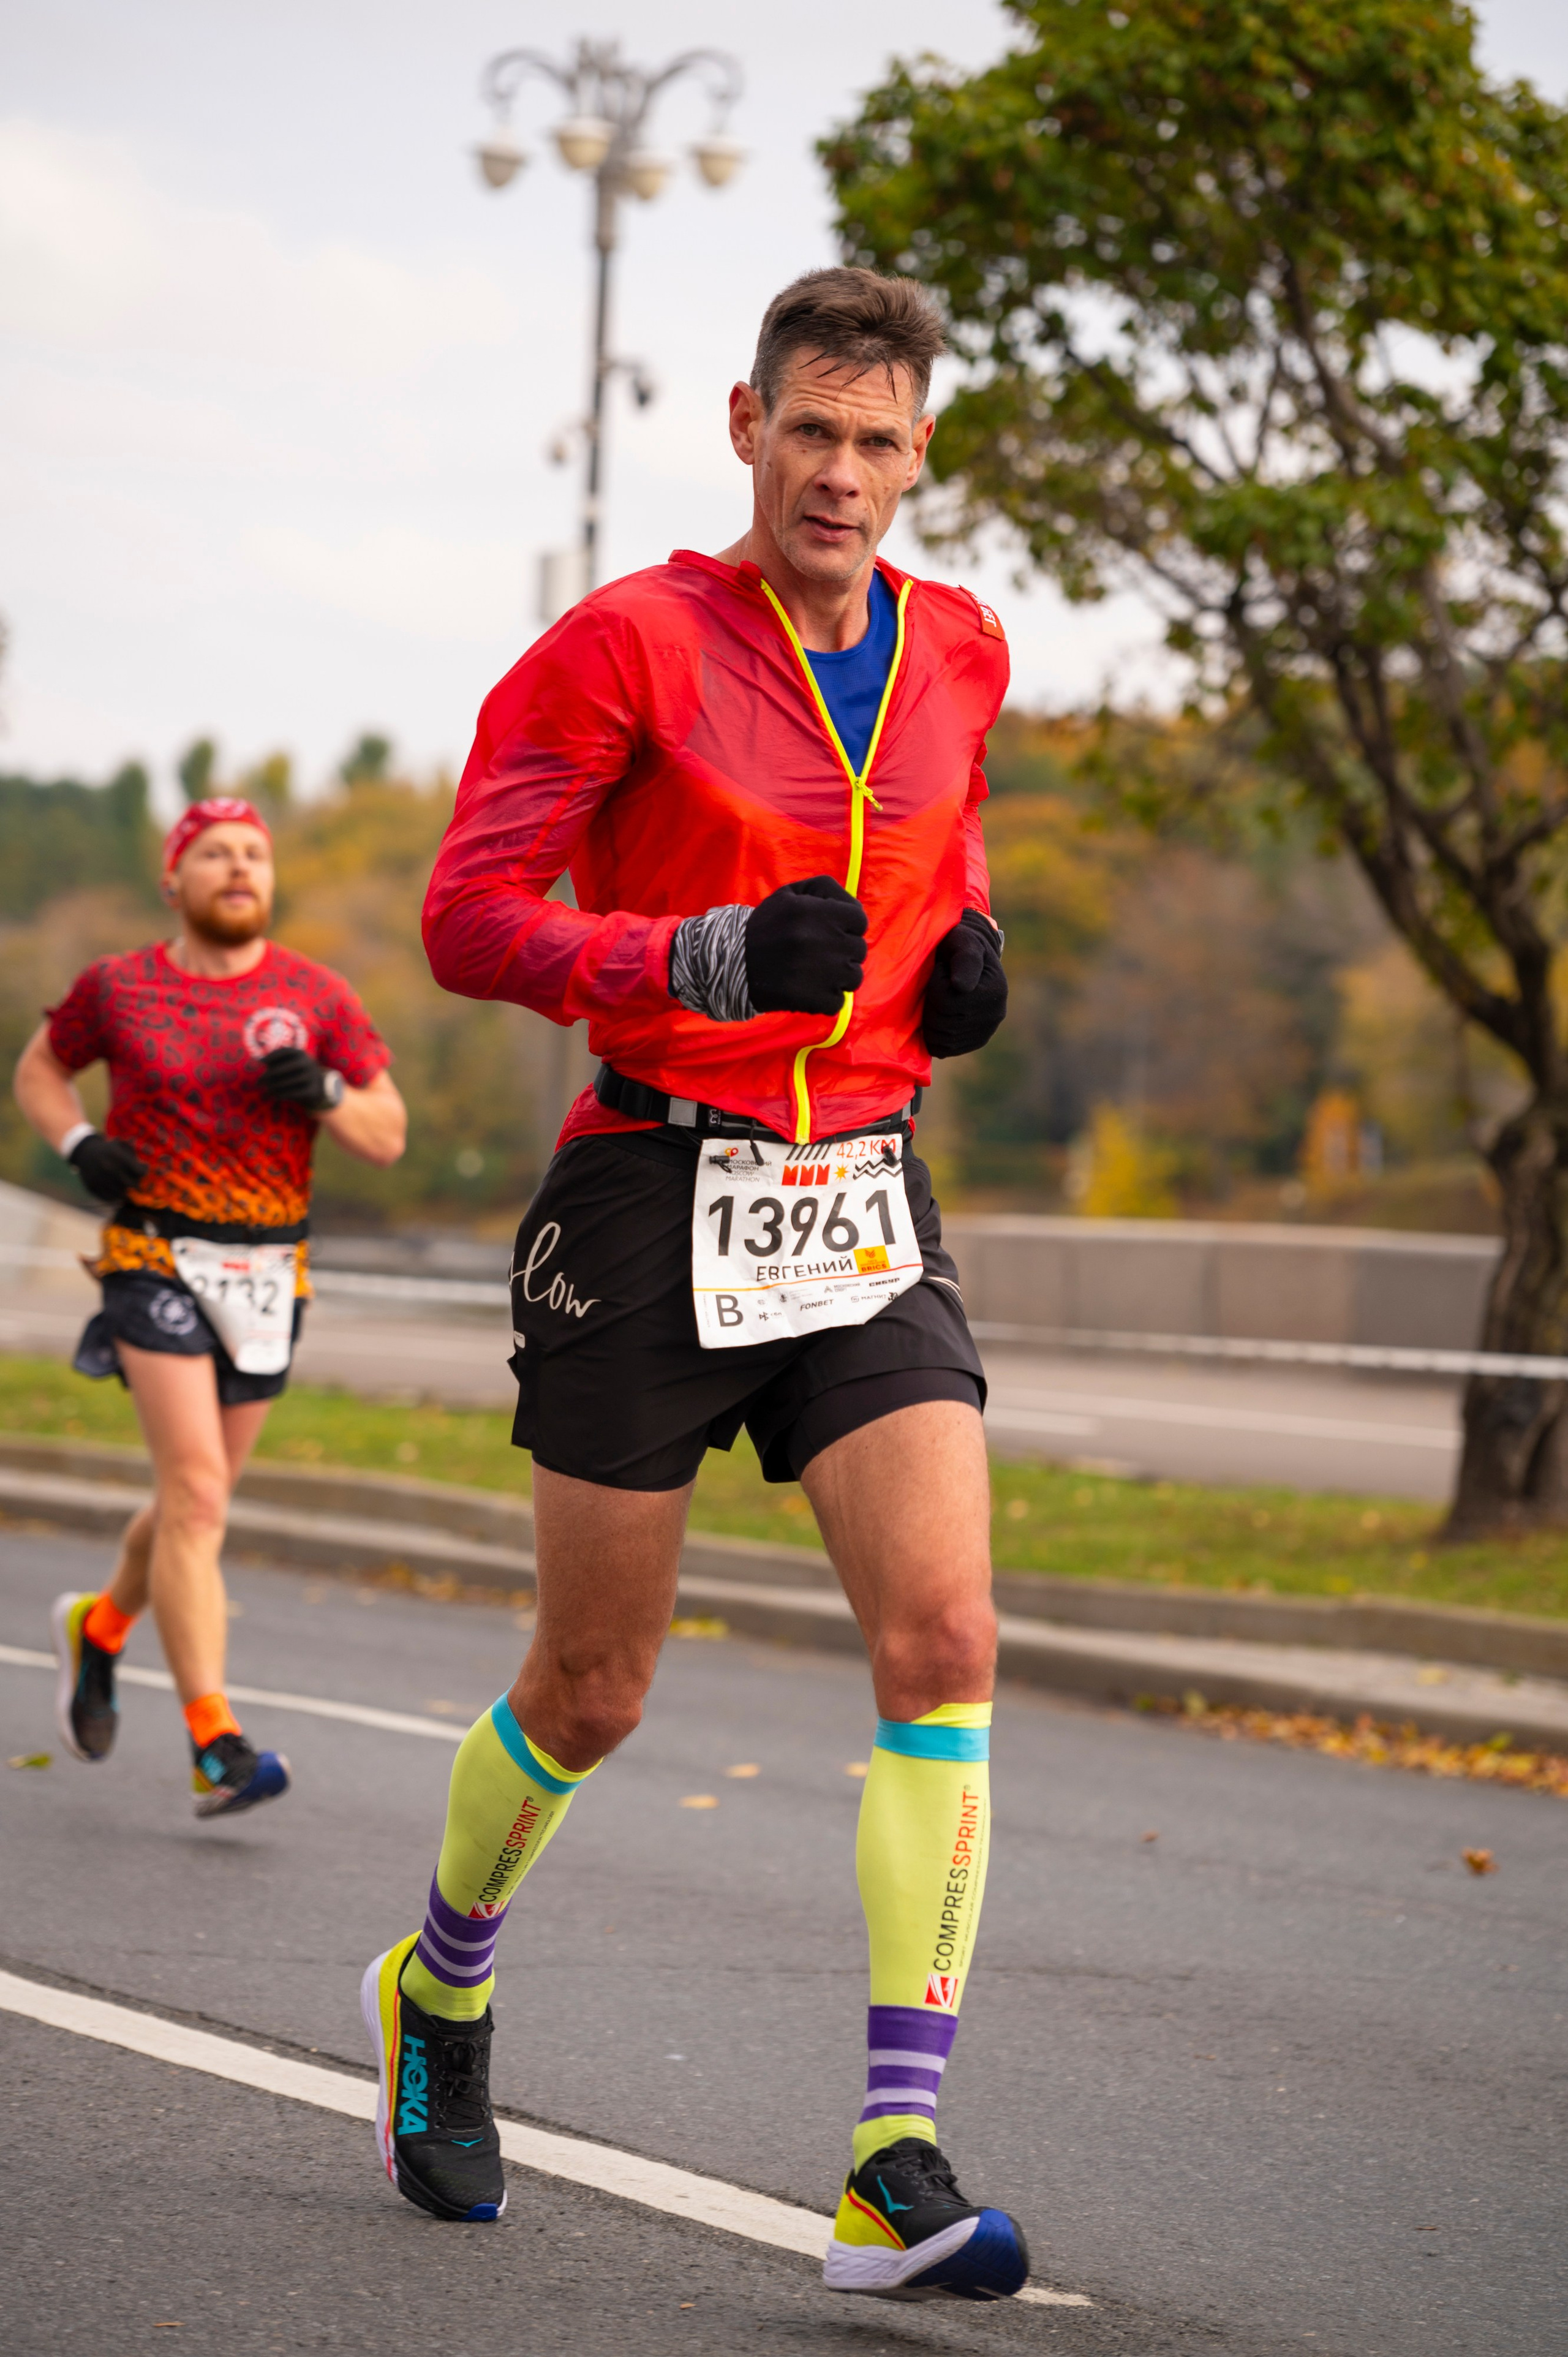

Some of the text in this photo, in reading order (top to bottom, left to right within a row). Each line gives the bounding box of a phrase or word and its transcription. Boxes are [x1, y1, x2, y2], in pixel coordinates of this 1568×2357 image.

[837, 1141, 866, 1160] 42,2
[709, 1190, 896, 1257] 13961
[509, 1221, 602, 1318] low
[756, 1256, 853, 1281] ЕВГЕНИЙ
[861, 1264, 887, 1272] BRICS
[800, 1299, 834, 1311] FONBET
[479, 1798, 542, 1903] COMPRESSPRINT
[933, 1791, 979, 1971] COMPRESSPRINT
[398, 2034, 429, 2135] HOKA
